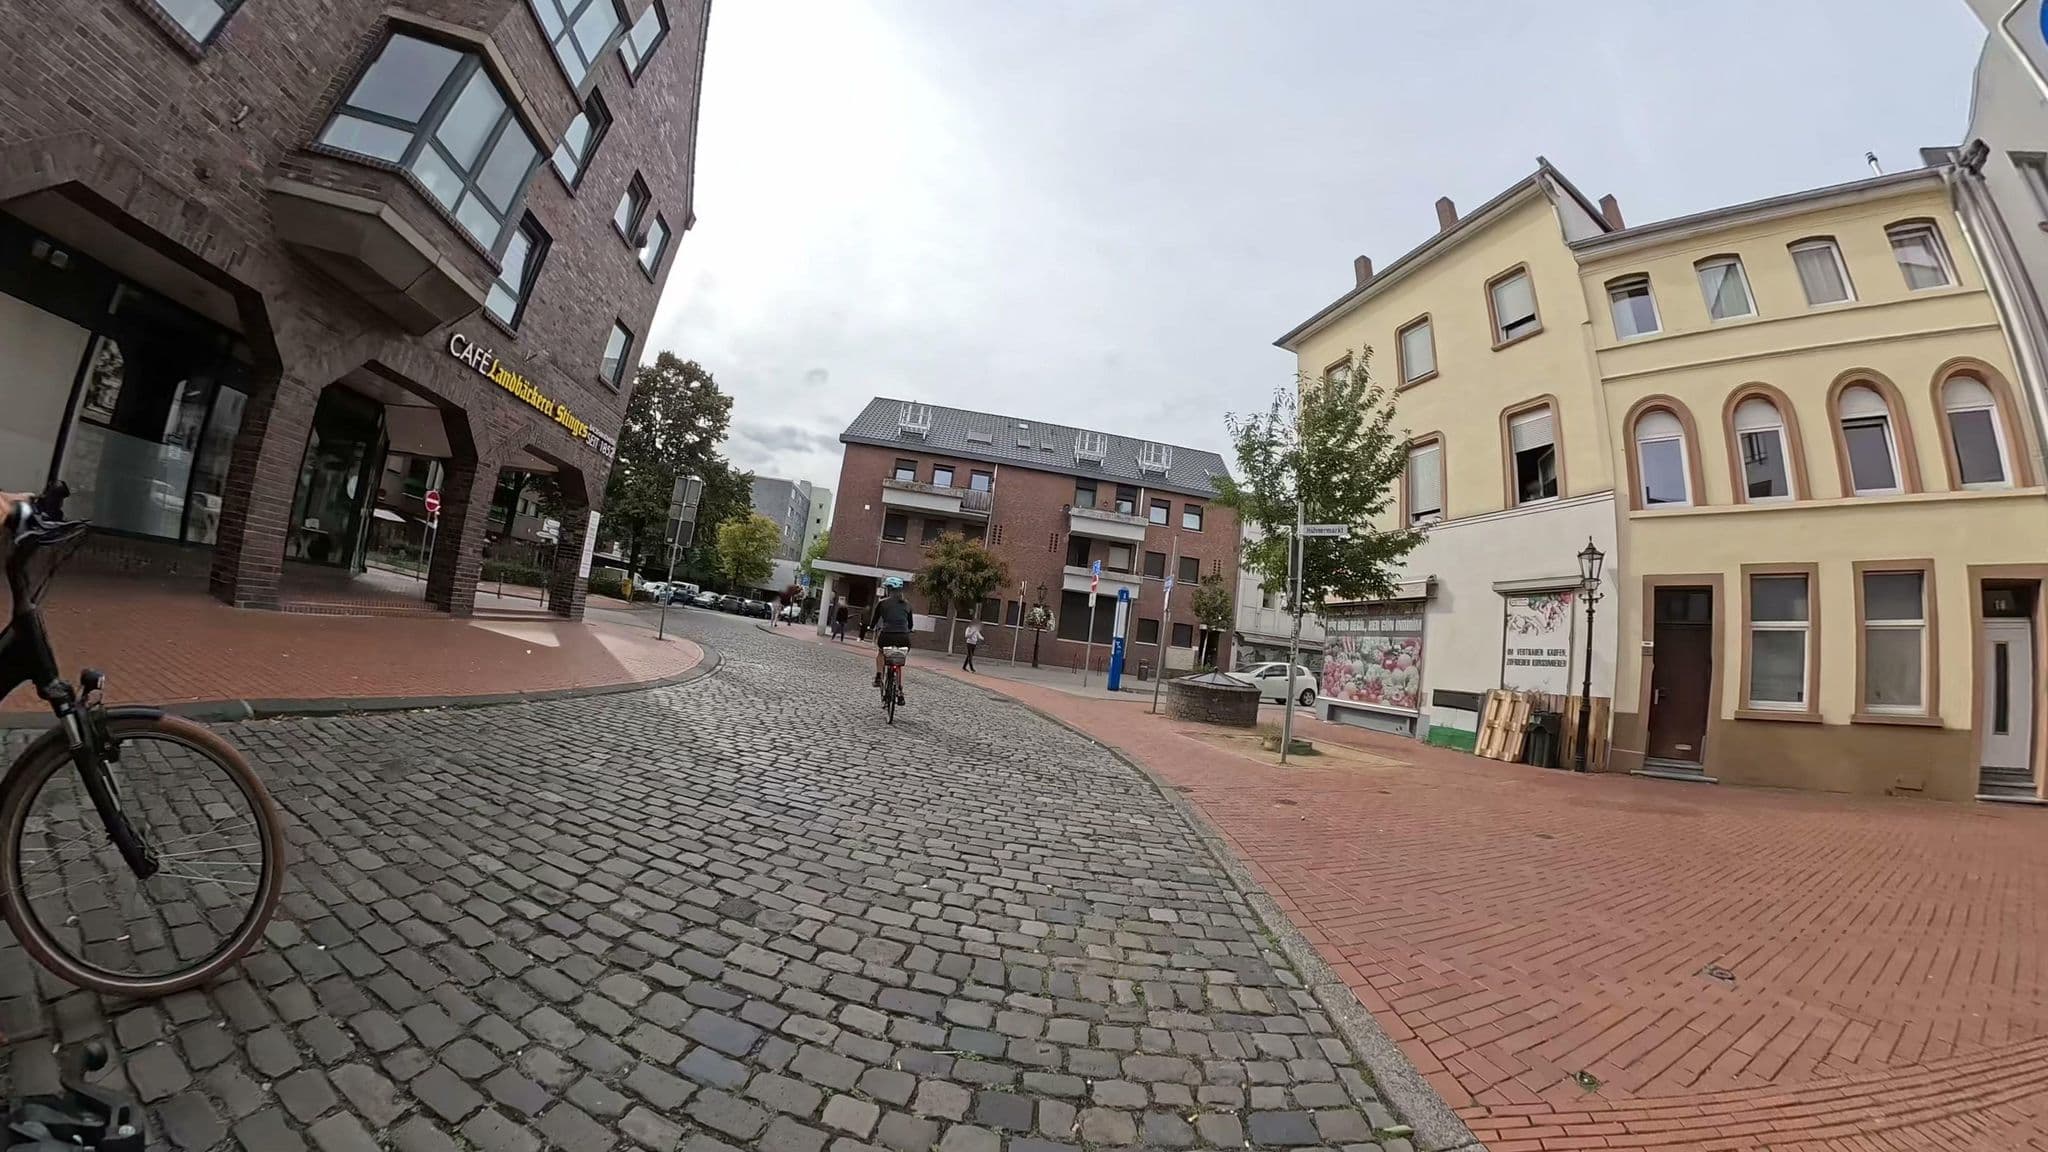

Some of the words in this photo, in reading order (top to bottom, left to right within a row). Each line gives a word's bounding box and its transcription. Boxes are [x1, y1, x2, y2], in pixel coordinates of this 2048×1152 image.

[450, 333, 493, 375] CAFÉ
[487, 358, 556, 417] Landbäckerei
[555, 404, 589, 438] Stinges
[586, 432, 600, 450] SEIT
